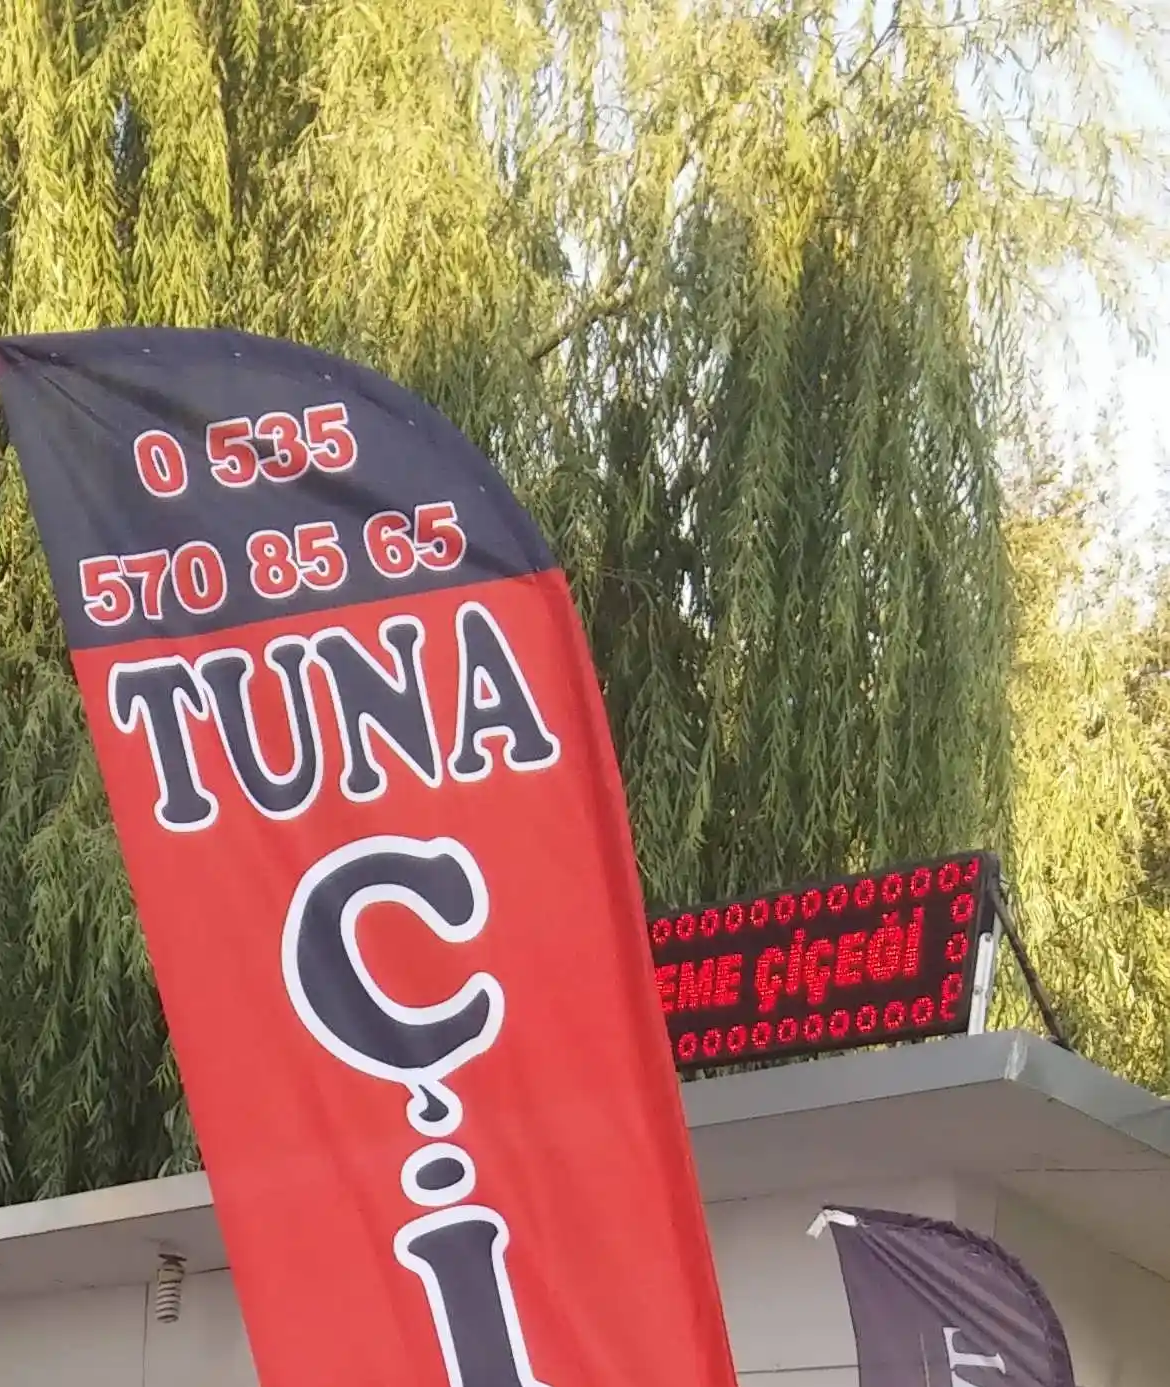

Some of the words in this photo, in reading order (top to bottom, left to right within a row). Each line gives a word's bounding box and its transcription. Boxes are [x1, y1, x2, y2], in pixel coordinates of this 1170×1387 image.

[134, 430, 188, 497] 0
[207, 402, 358, 488] 535
[79, 541, 228, 627] 570
[246, 521, 348, 599] 85
[363, 501, 467, 579] 65
[108, 600, 560, 833] TUNA
[754, 905, 926, 1013] ÇİÇEĞİ
